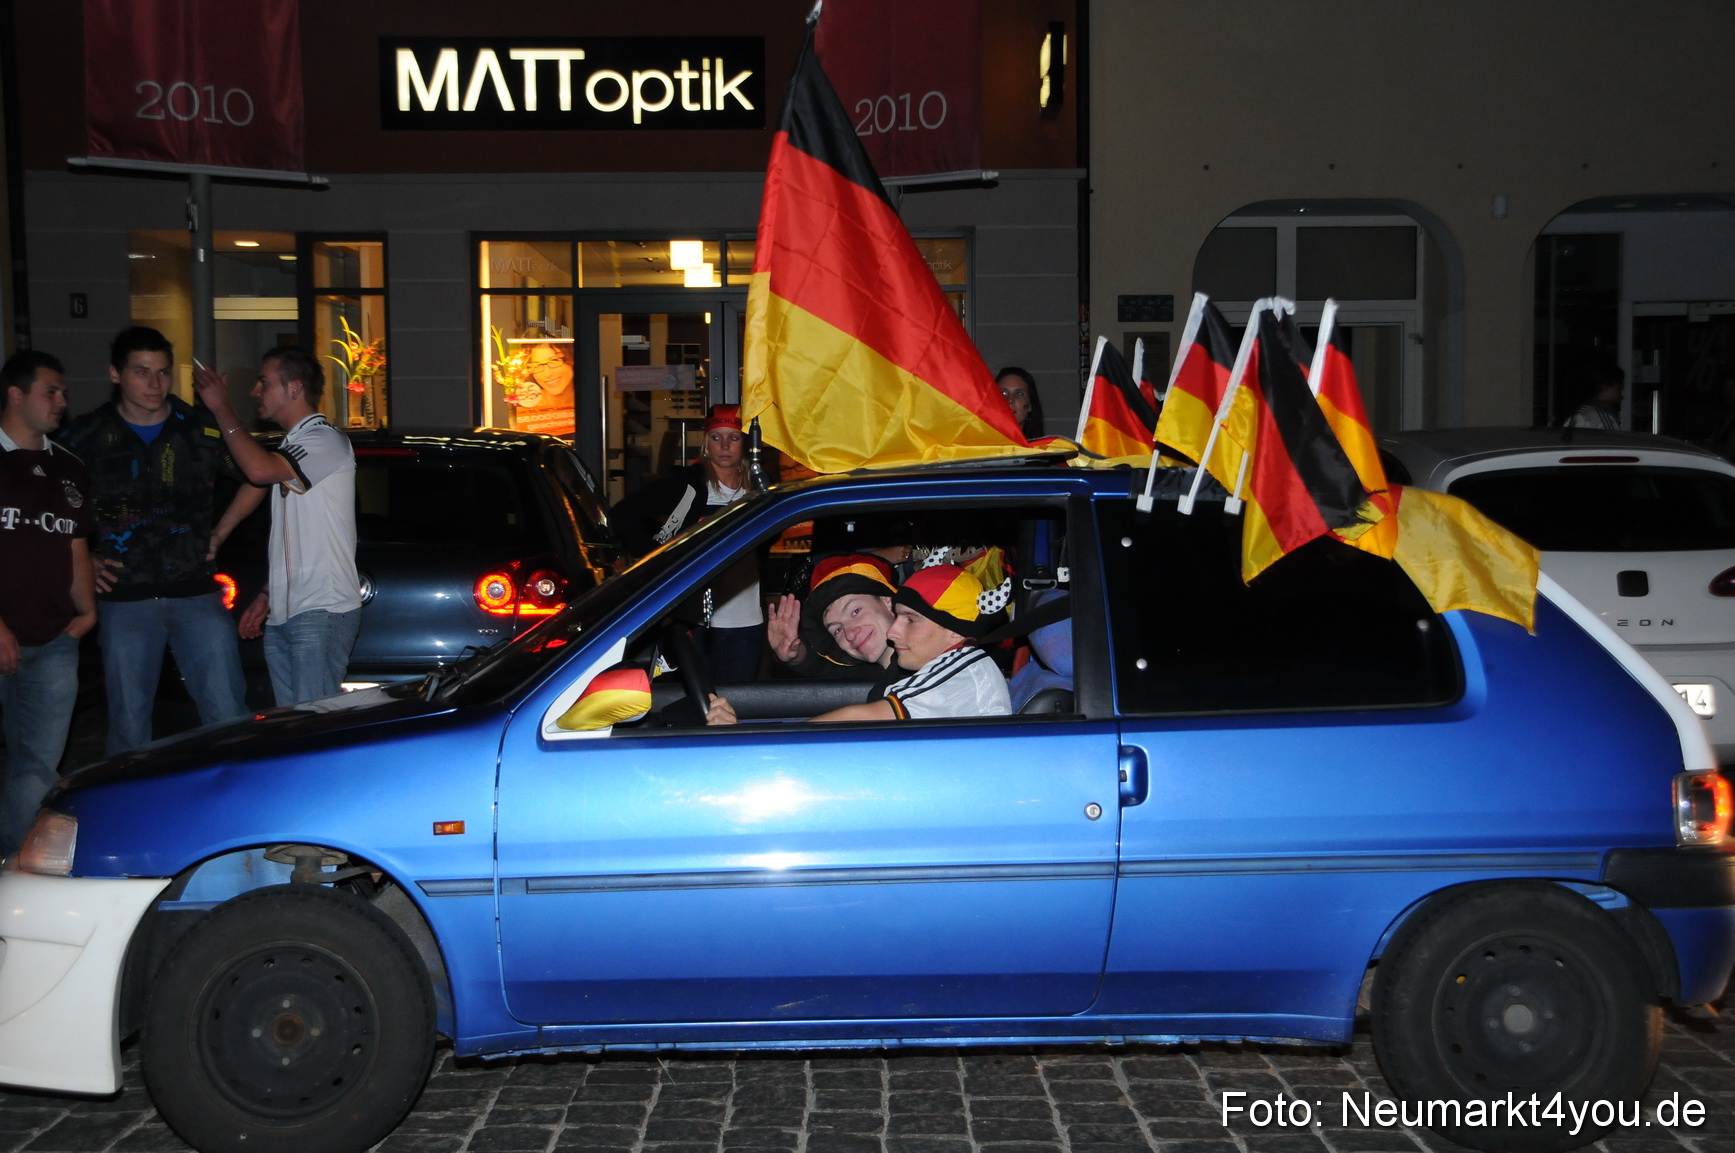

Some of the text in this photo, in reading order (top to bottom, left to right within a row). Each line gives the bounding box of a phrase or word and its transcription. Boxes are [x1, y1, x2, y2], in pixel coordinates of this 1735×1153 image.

[135, 80, 255, 127] 2010
[854, 91, 947, 137] 2010
[74, 297, 84, 314] 6
[1617, 619, 1674, 627] EON
